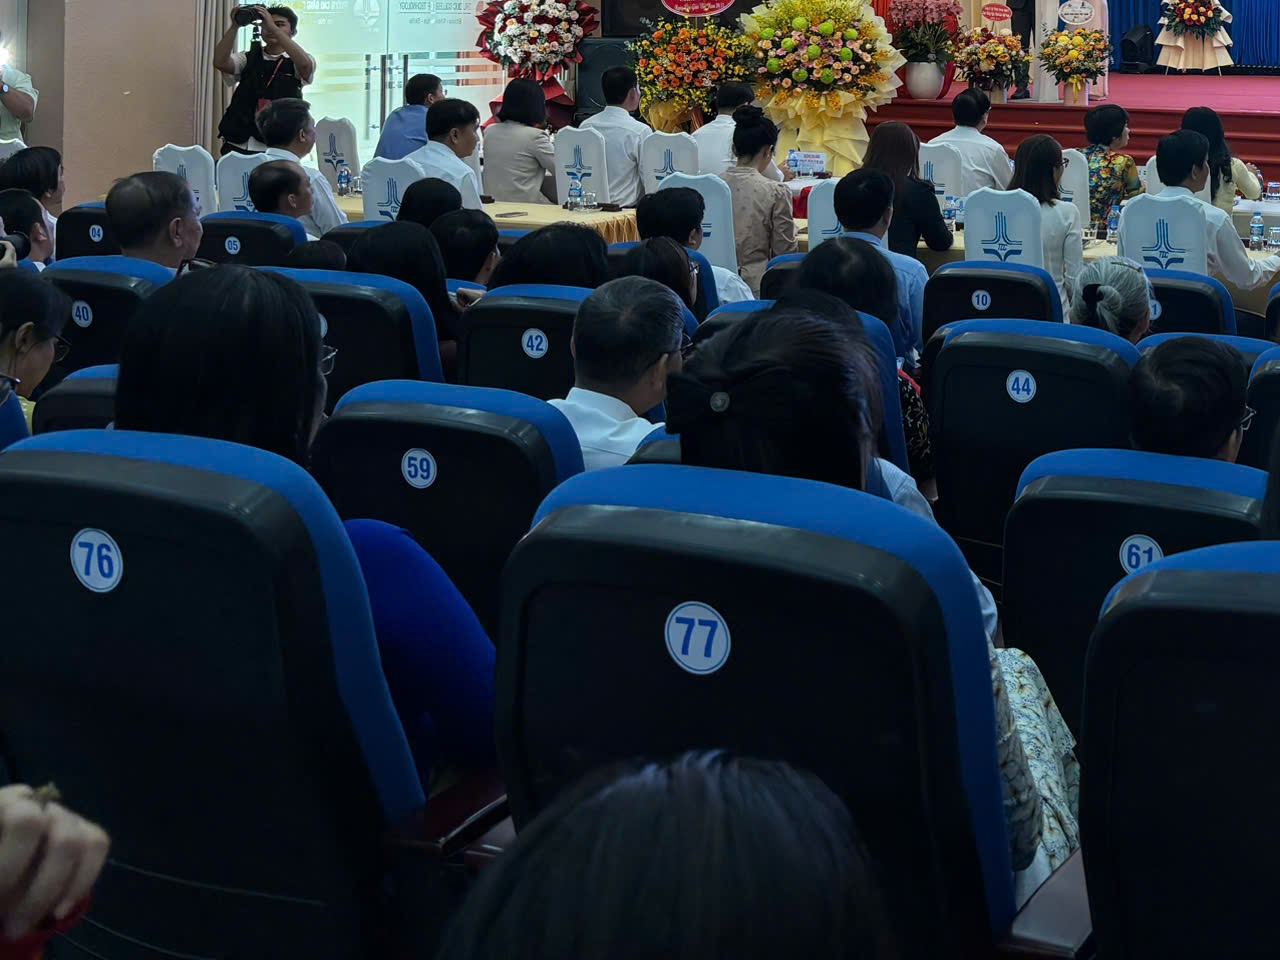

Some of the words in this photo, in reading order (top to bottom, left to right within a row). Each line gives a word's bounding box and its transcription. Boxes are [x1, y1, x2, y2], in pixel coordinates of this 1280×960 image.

[92, 227, 101, 238] 04
[227, 240, 238, 251] 05
[975, 294, 988, 307] 10
[75, 306, 89, 322] 40
[526, 335, 544, 352] 42
[1011, 376, 1031, 395] 44
[407, 456, 431, 480] 59
[78, 541, 114, 579] 76
[1127, 543, 1154, 569] 61
[675, 616, 719, 658] 77
